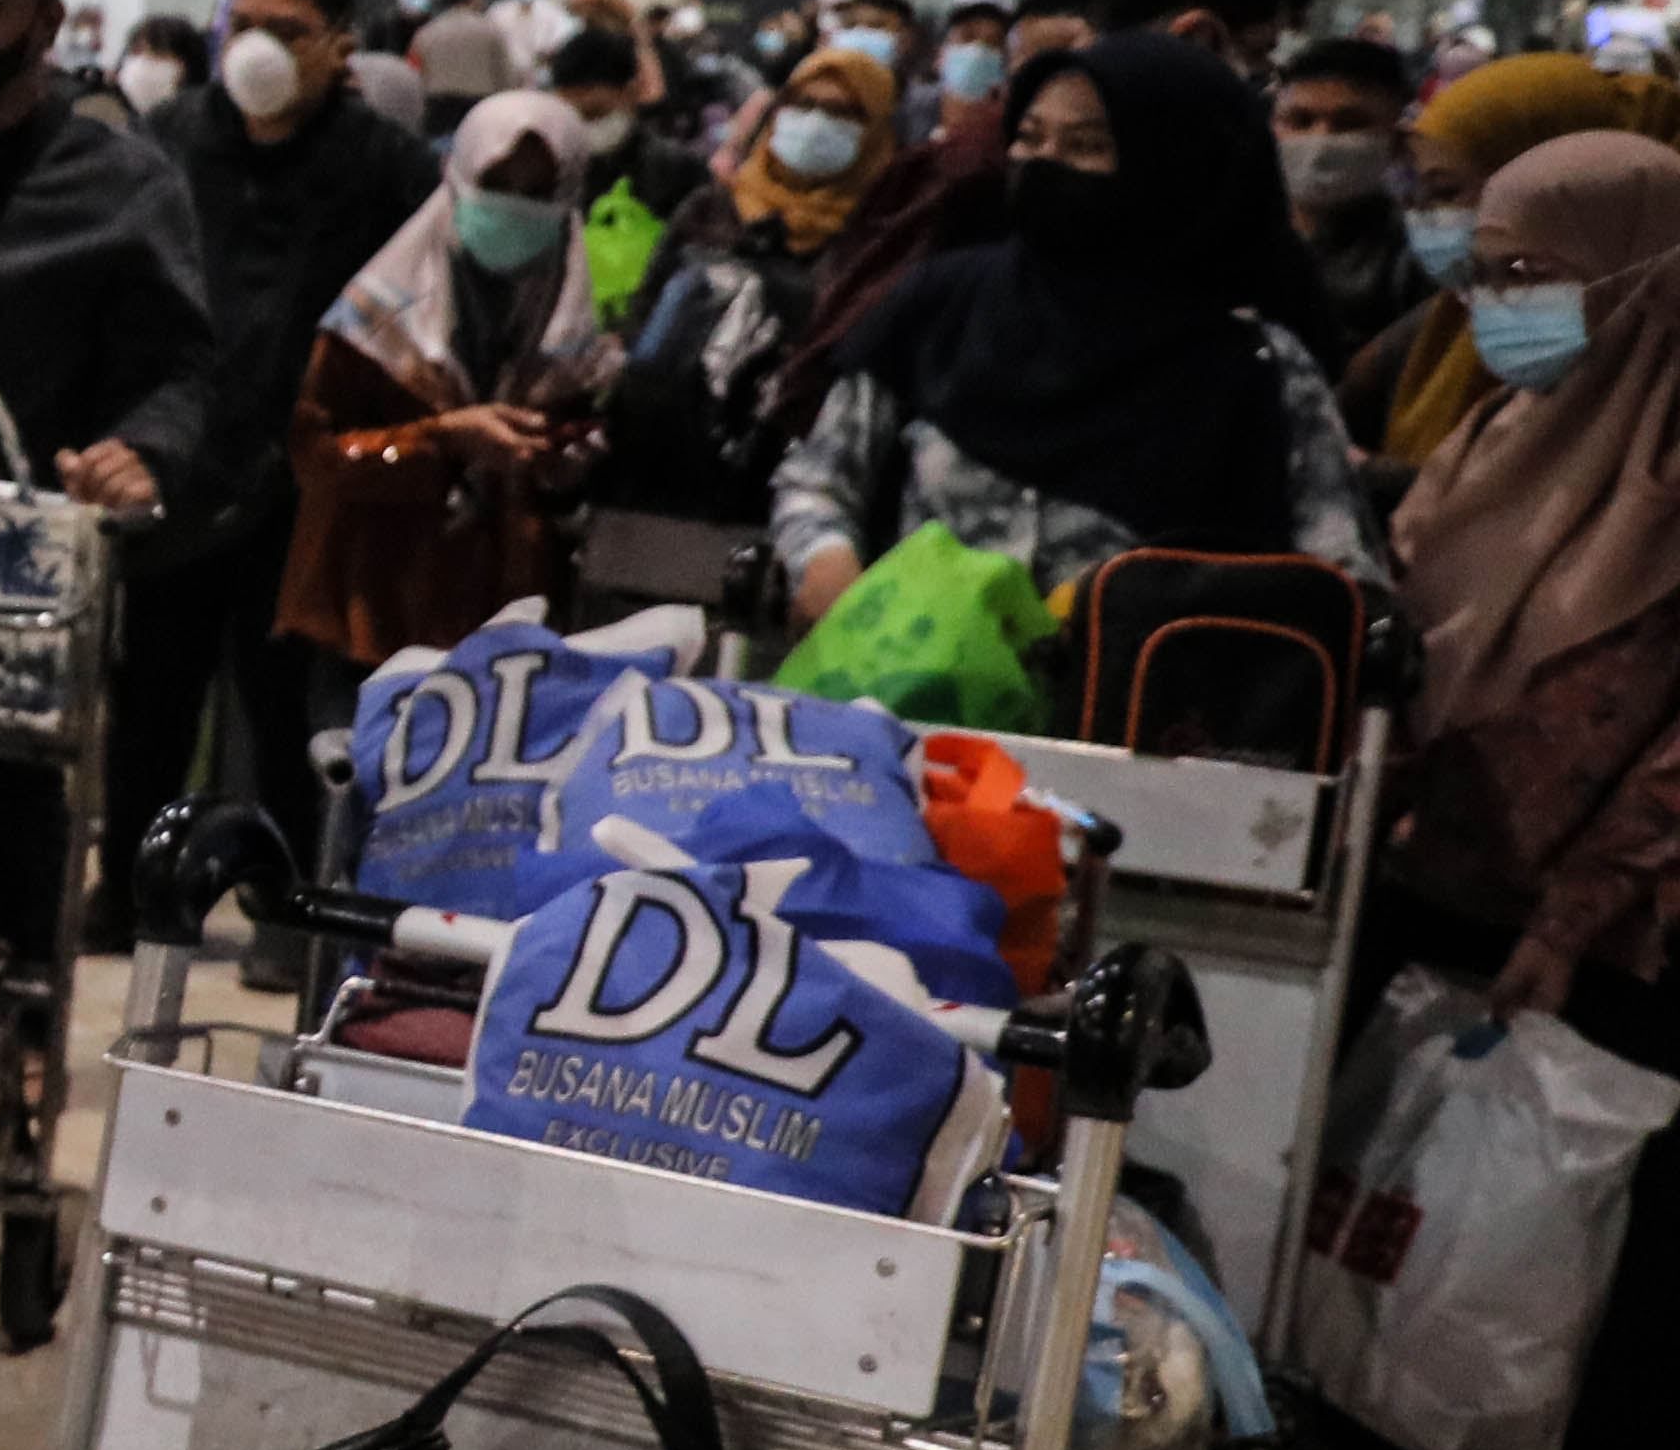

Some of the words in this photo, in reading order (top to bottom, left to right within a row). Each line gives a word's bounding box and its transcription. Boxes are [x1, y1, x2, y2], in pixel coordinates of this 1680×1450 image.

[375, 652, 573, 814] DL
[611, 676, 856, 771] DL
[526, 856, 864, 1099] DL
[506, 1049, 655, 1118] BUSANA
[660, 1076, 822, 1161] MUSLIM
